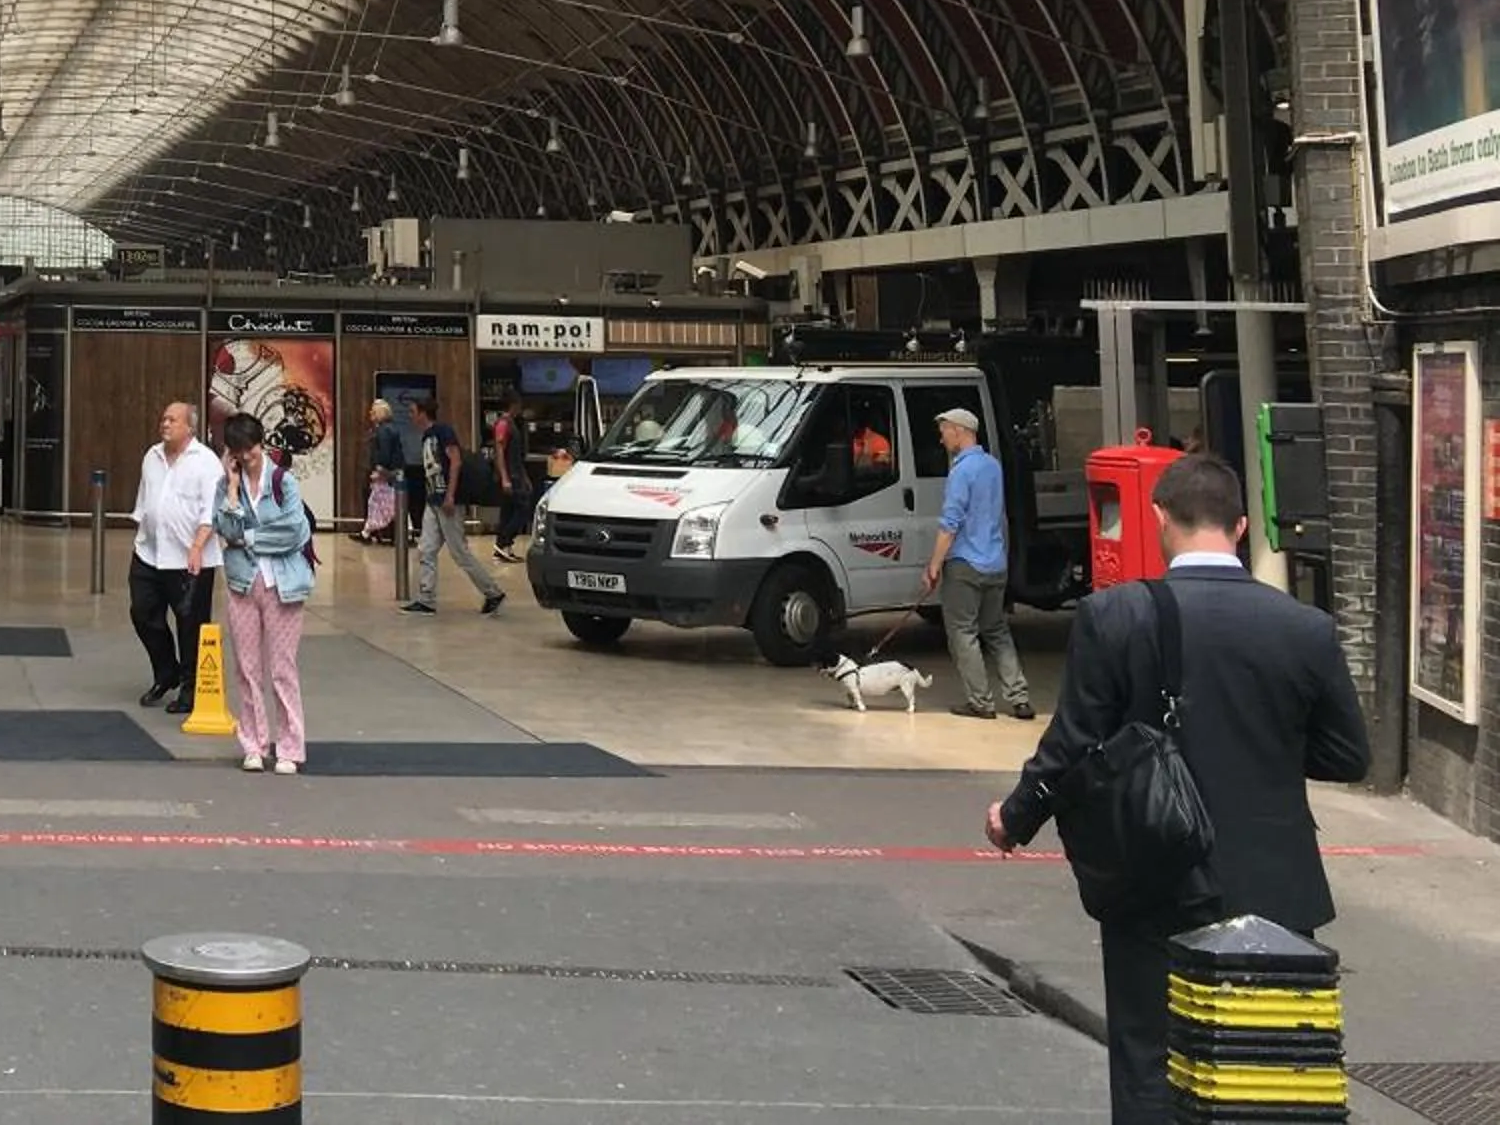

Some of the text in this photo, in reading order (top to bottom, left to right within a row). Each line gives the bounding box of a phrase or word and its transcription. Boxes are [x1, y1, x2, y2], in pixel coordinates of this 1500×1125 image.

[1450, 138, 1475, 166] from
[491, 321, 592, 340] nam-po!
[849, 530, 903, 543] Network Rail
[20, 834, 133, 843] SMOKING
[251, 837, 304, 845] THIS
[476, 842, 514, 851] NO
[521, 842, 637, 853] SMOKING
